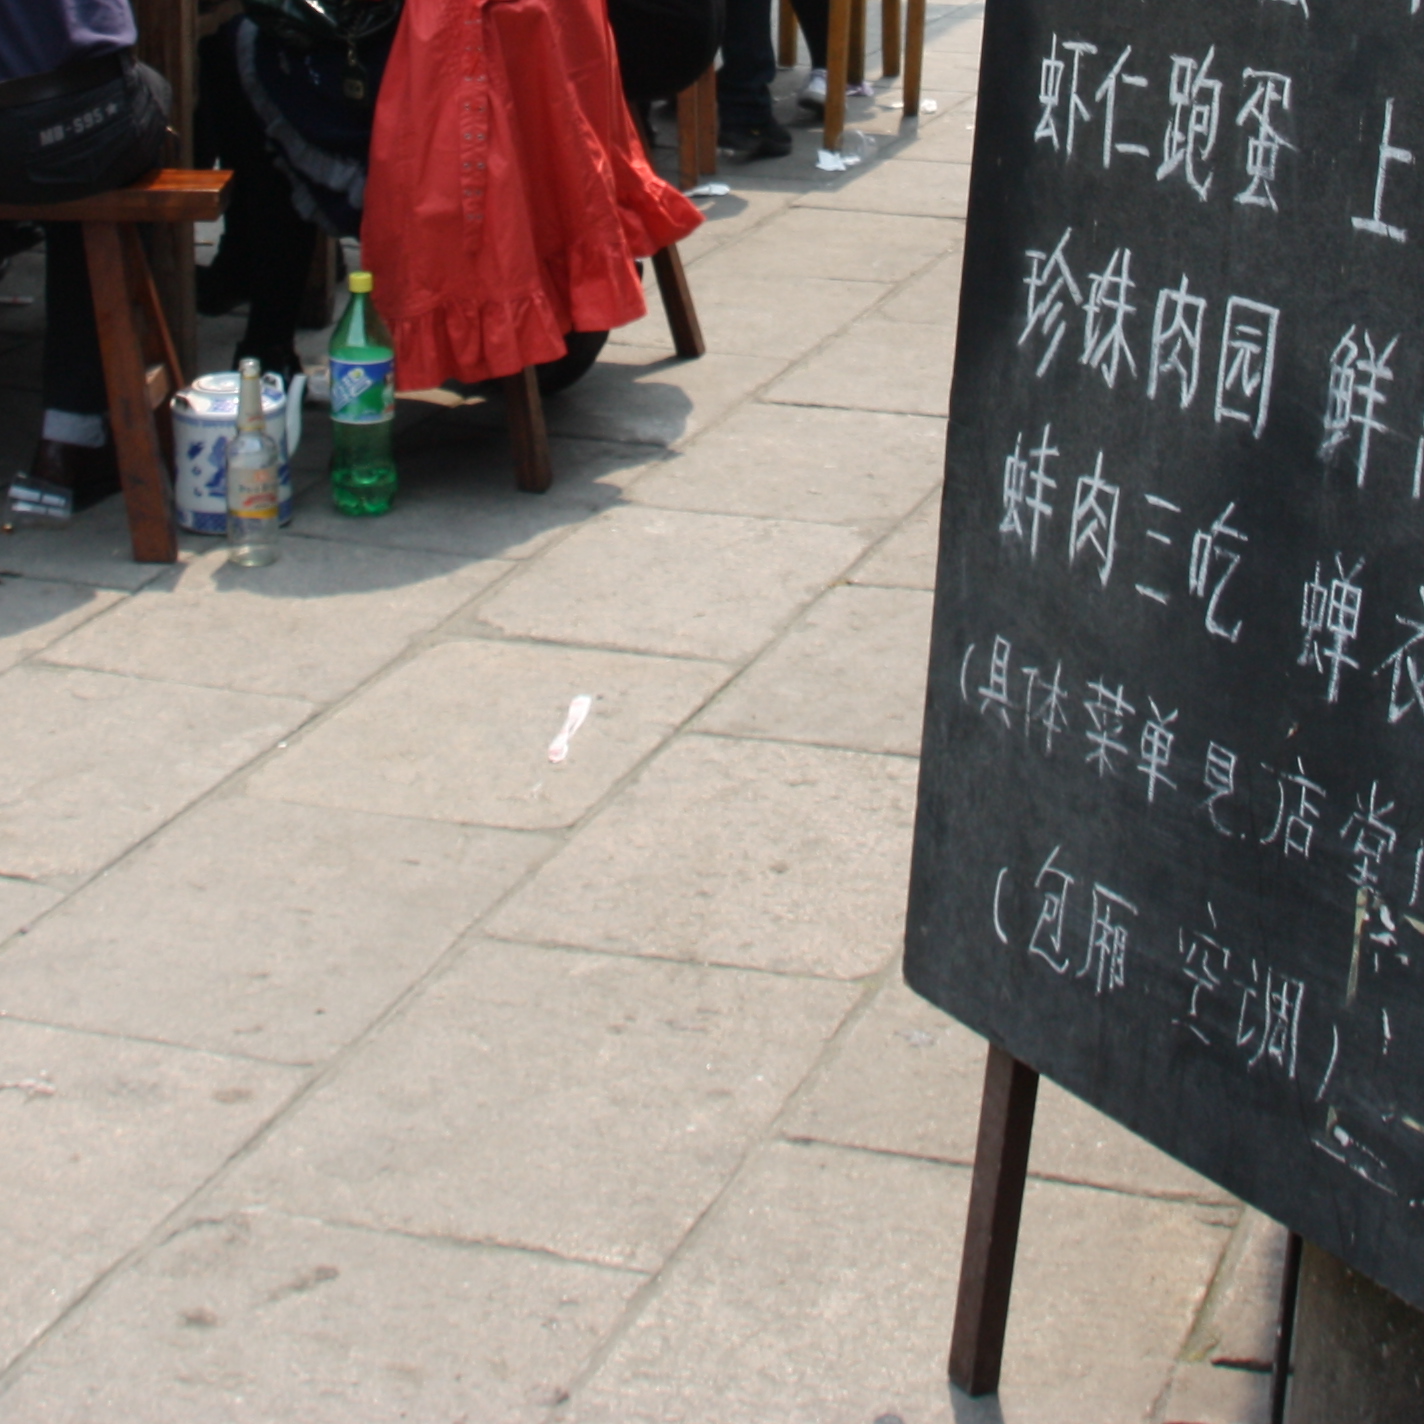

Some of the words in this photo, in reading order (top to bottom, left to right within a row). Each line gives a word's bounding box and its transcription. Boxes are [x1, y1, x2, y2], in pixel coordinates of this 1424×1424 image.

[1032, 31, 1301, 213] 虾仁跑蛋
[1017, 226, 1280, 440] 珍珠肉园
[998, 422, 1249, 643] 蚌肉三吃
